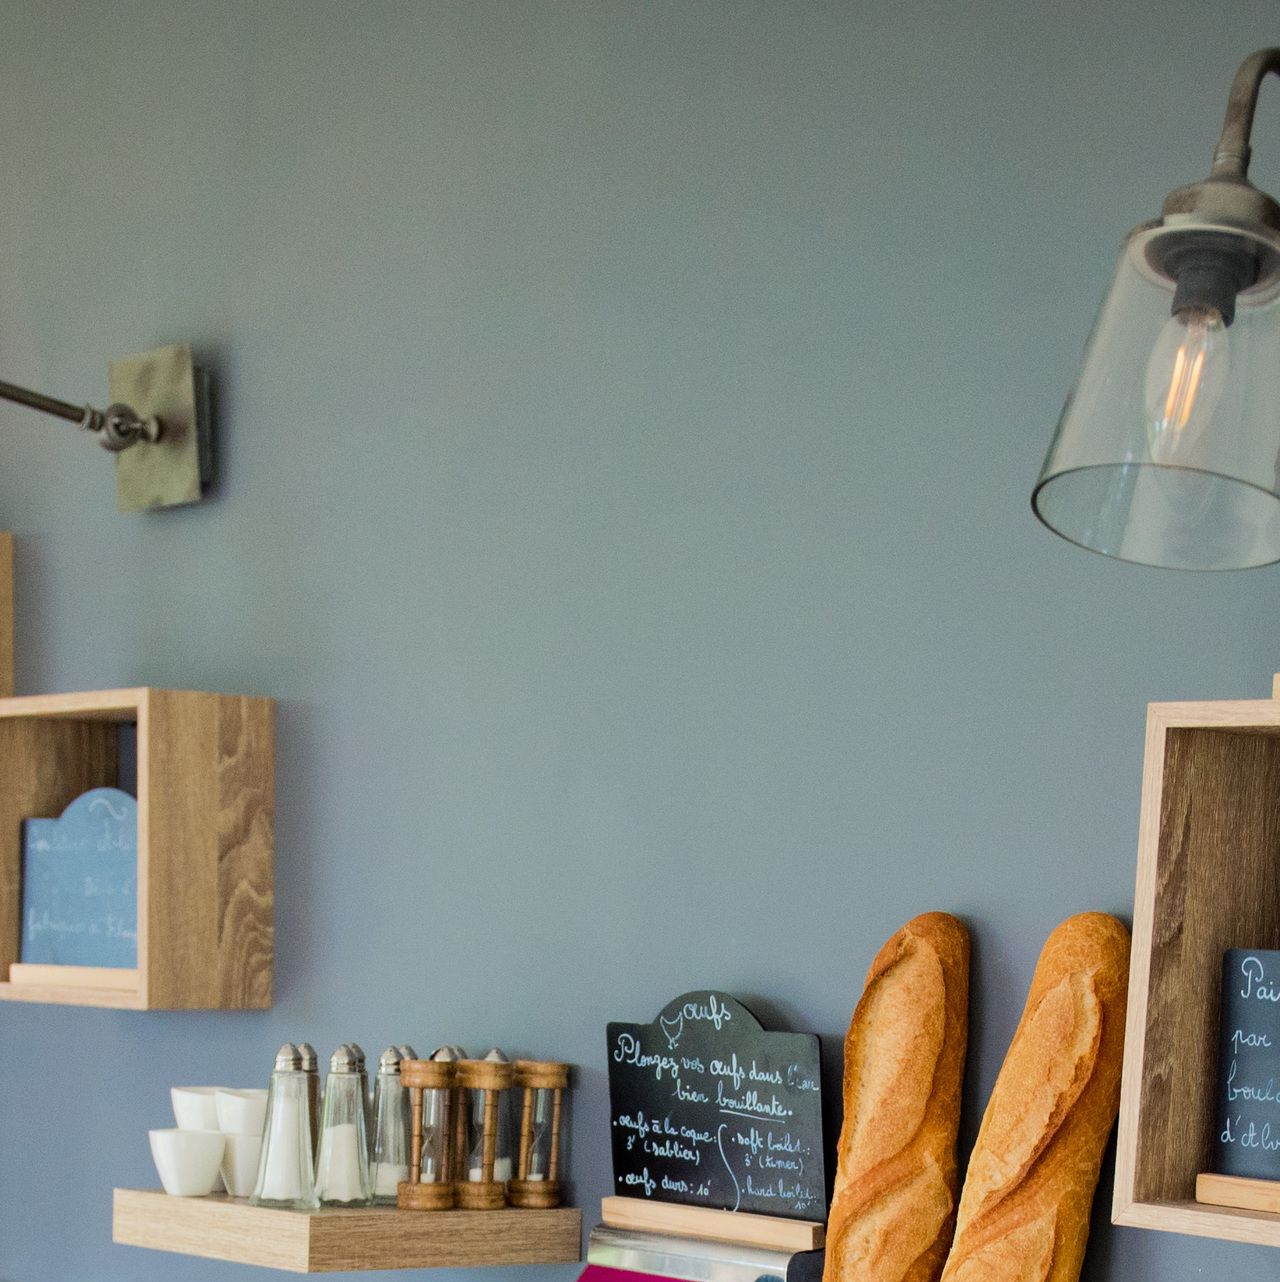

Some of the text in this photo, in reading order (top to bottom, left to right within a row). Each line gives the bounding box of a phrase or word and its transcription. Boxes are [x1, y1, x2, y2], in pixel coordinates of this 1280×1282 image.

[1231, 1029, 1271, 1054] par
[614, 1033, 679, 1080] Plongez
[681, 1057, 704, 1073] vos
[749, 1060, 783, 1084] dans
[672, 1078, 708, 1102] bien
[736, 1127, 763, 1154] soft
